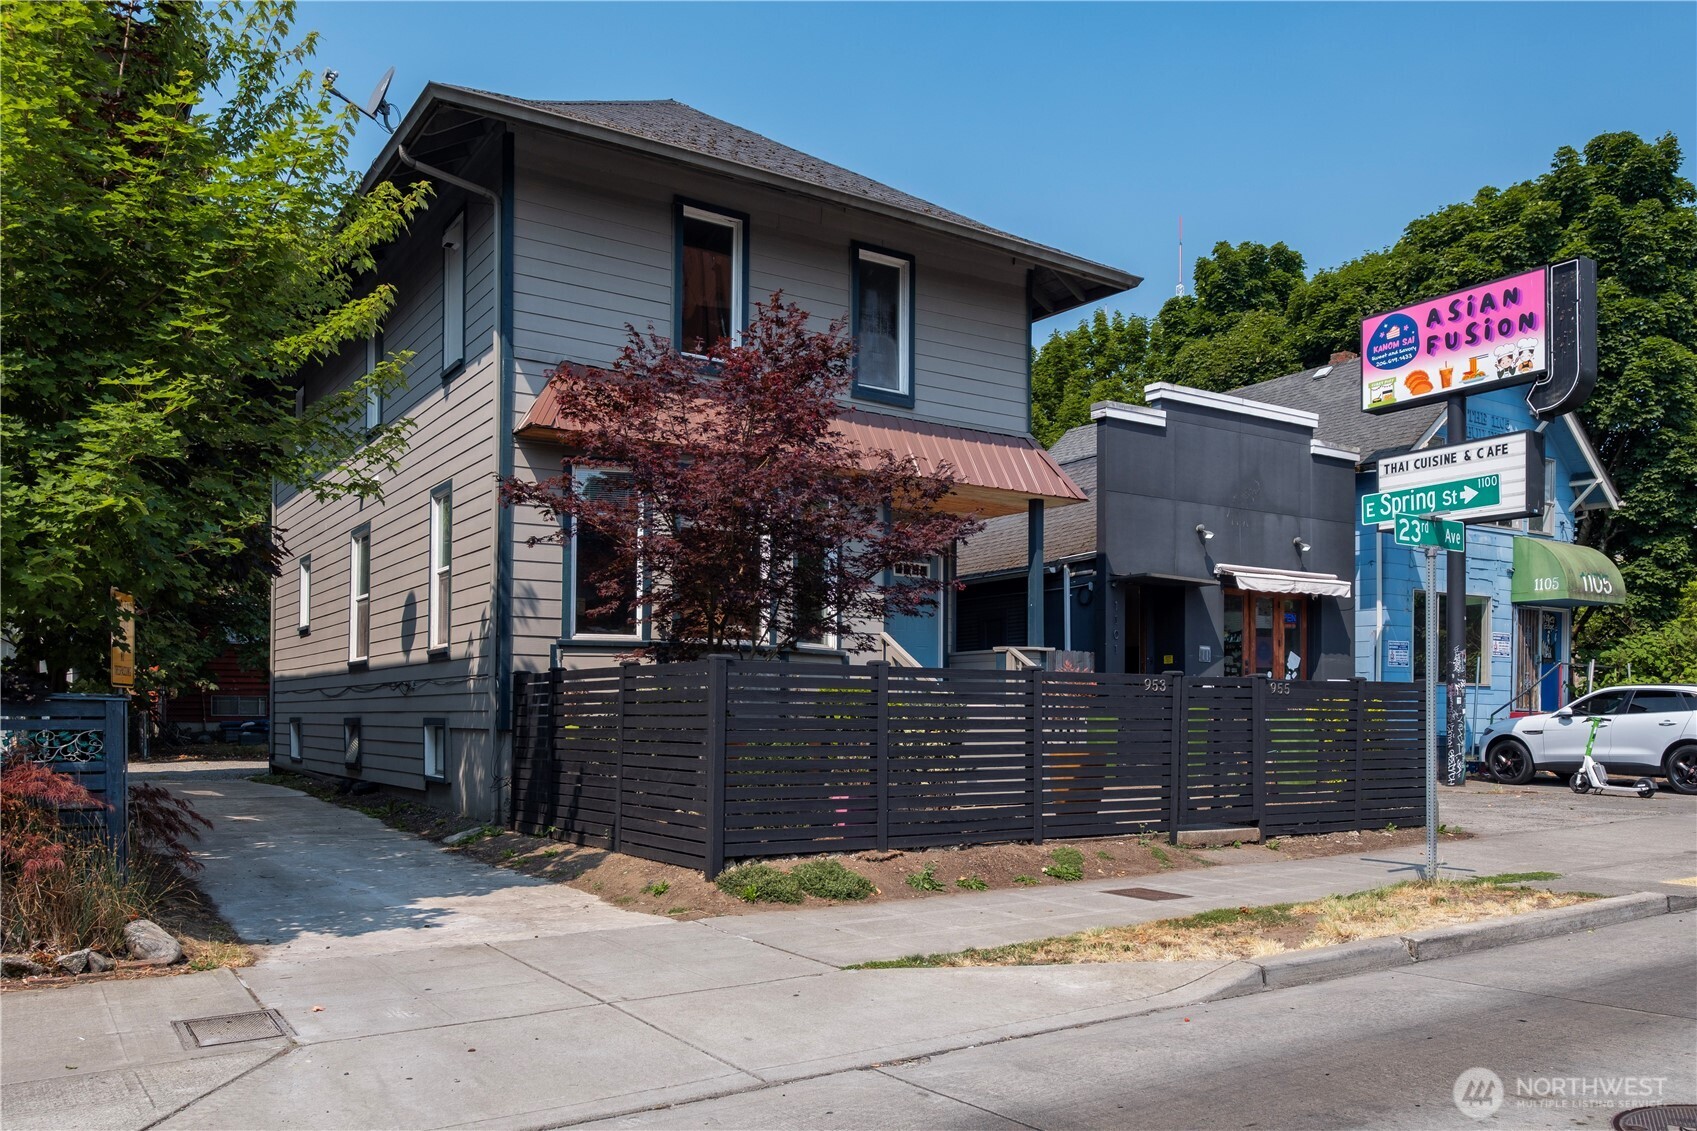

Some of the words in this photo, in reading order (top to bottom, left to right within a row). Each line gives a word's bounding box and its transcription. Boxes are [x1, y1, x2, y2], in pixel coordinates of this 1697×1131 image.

[1373, 340, 1399, 354] KANOM
[1402, 336, 1415, 346] SAI
[1384, 461, 1409, 475] THAI
[1414, 453, 1457, 469] CUISINE
[1464, 450, 1471, 461] &
[1477, 443, 1508, 459] CAFE
[1477, 476, 1498, 489] 1100
[1366, 502, 1376, 518] E
[1380, 489, 1436, 518] Spring
[1442, 490, 1458, 506] St
[1399, 518, 1430, 543] 23rd
[1444, 528, 1461, 545] Ave
[1534, 577, 1560, 591] 1105
[1582, 574, 1613, 595] 1105
[1284, 613, 1297, 623] PEN
[1144, 678, 1167, 692] 953
[1270, 681, 1290, 695] 955
